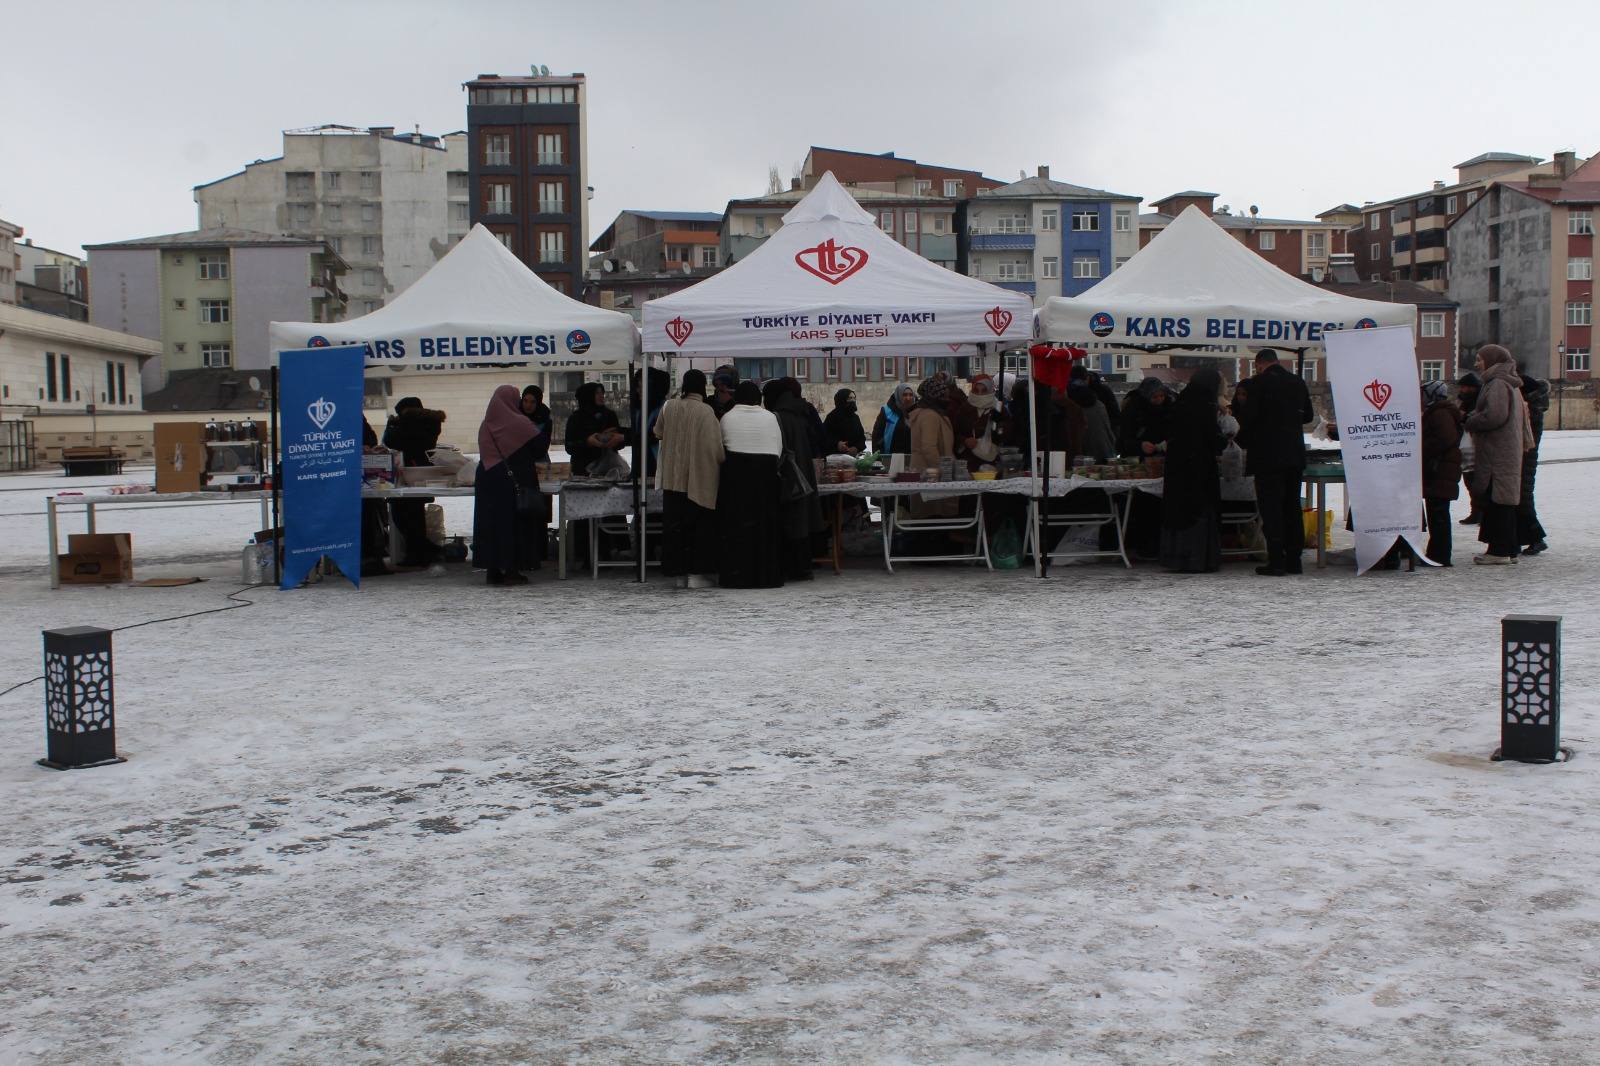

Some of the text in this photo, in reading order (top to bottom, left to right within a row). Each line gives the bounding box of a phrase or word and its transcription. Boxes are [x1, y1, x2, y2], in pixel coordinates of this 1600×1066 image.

[742, 312, 936, 329] TÜRKİYE DİYANET VAKFI
[1126, 317, 1191, 338] KARS
[790, 325, 889, 342] KARS ŞUBESİ
[341, 339, 406, 359] ARS
[1361, 412, 1402, 423] TÜRKİYE
[302, 430, 342, 442] TÜRKİYE
[1347, 424, 1388, 435] DİYANET
[288, 442, 327, 454] DİYANET
[330, 439, 355, 449] VAKFI
